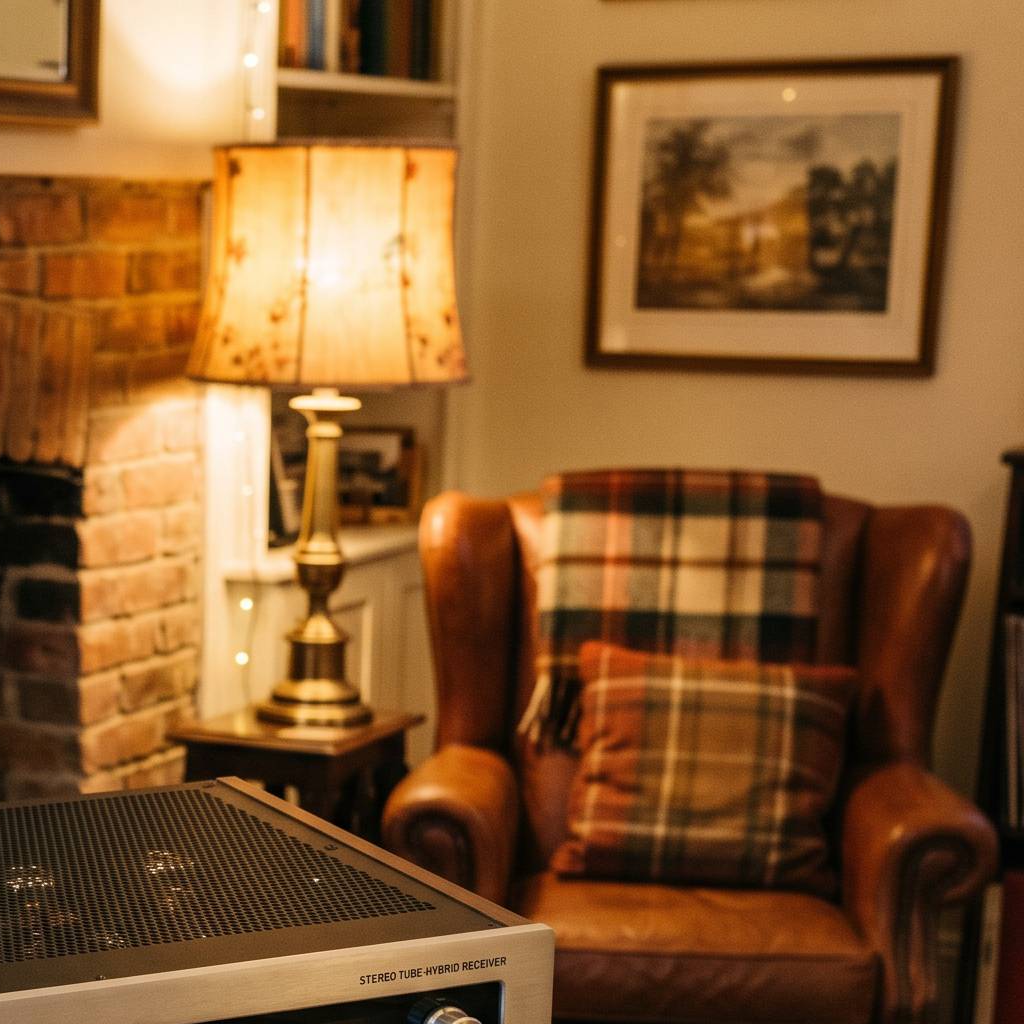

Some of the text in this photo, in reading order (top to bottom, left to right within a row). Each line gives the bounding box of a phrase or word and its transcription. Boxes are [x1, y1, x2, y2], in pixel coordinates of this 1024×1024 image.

[359, 956, 507, 986] STEREO TUBE-HYBRID RECEIVER
